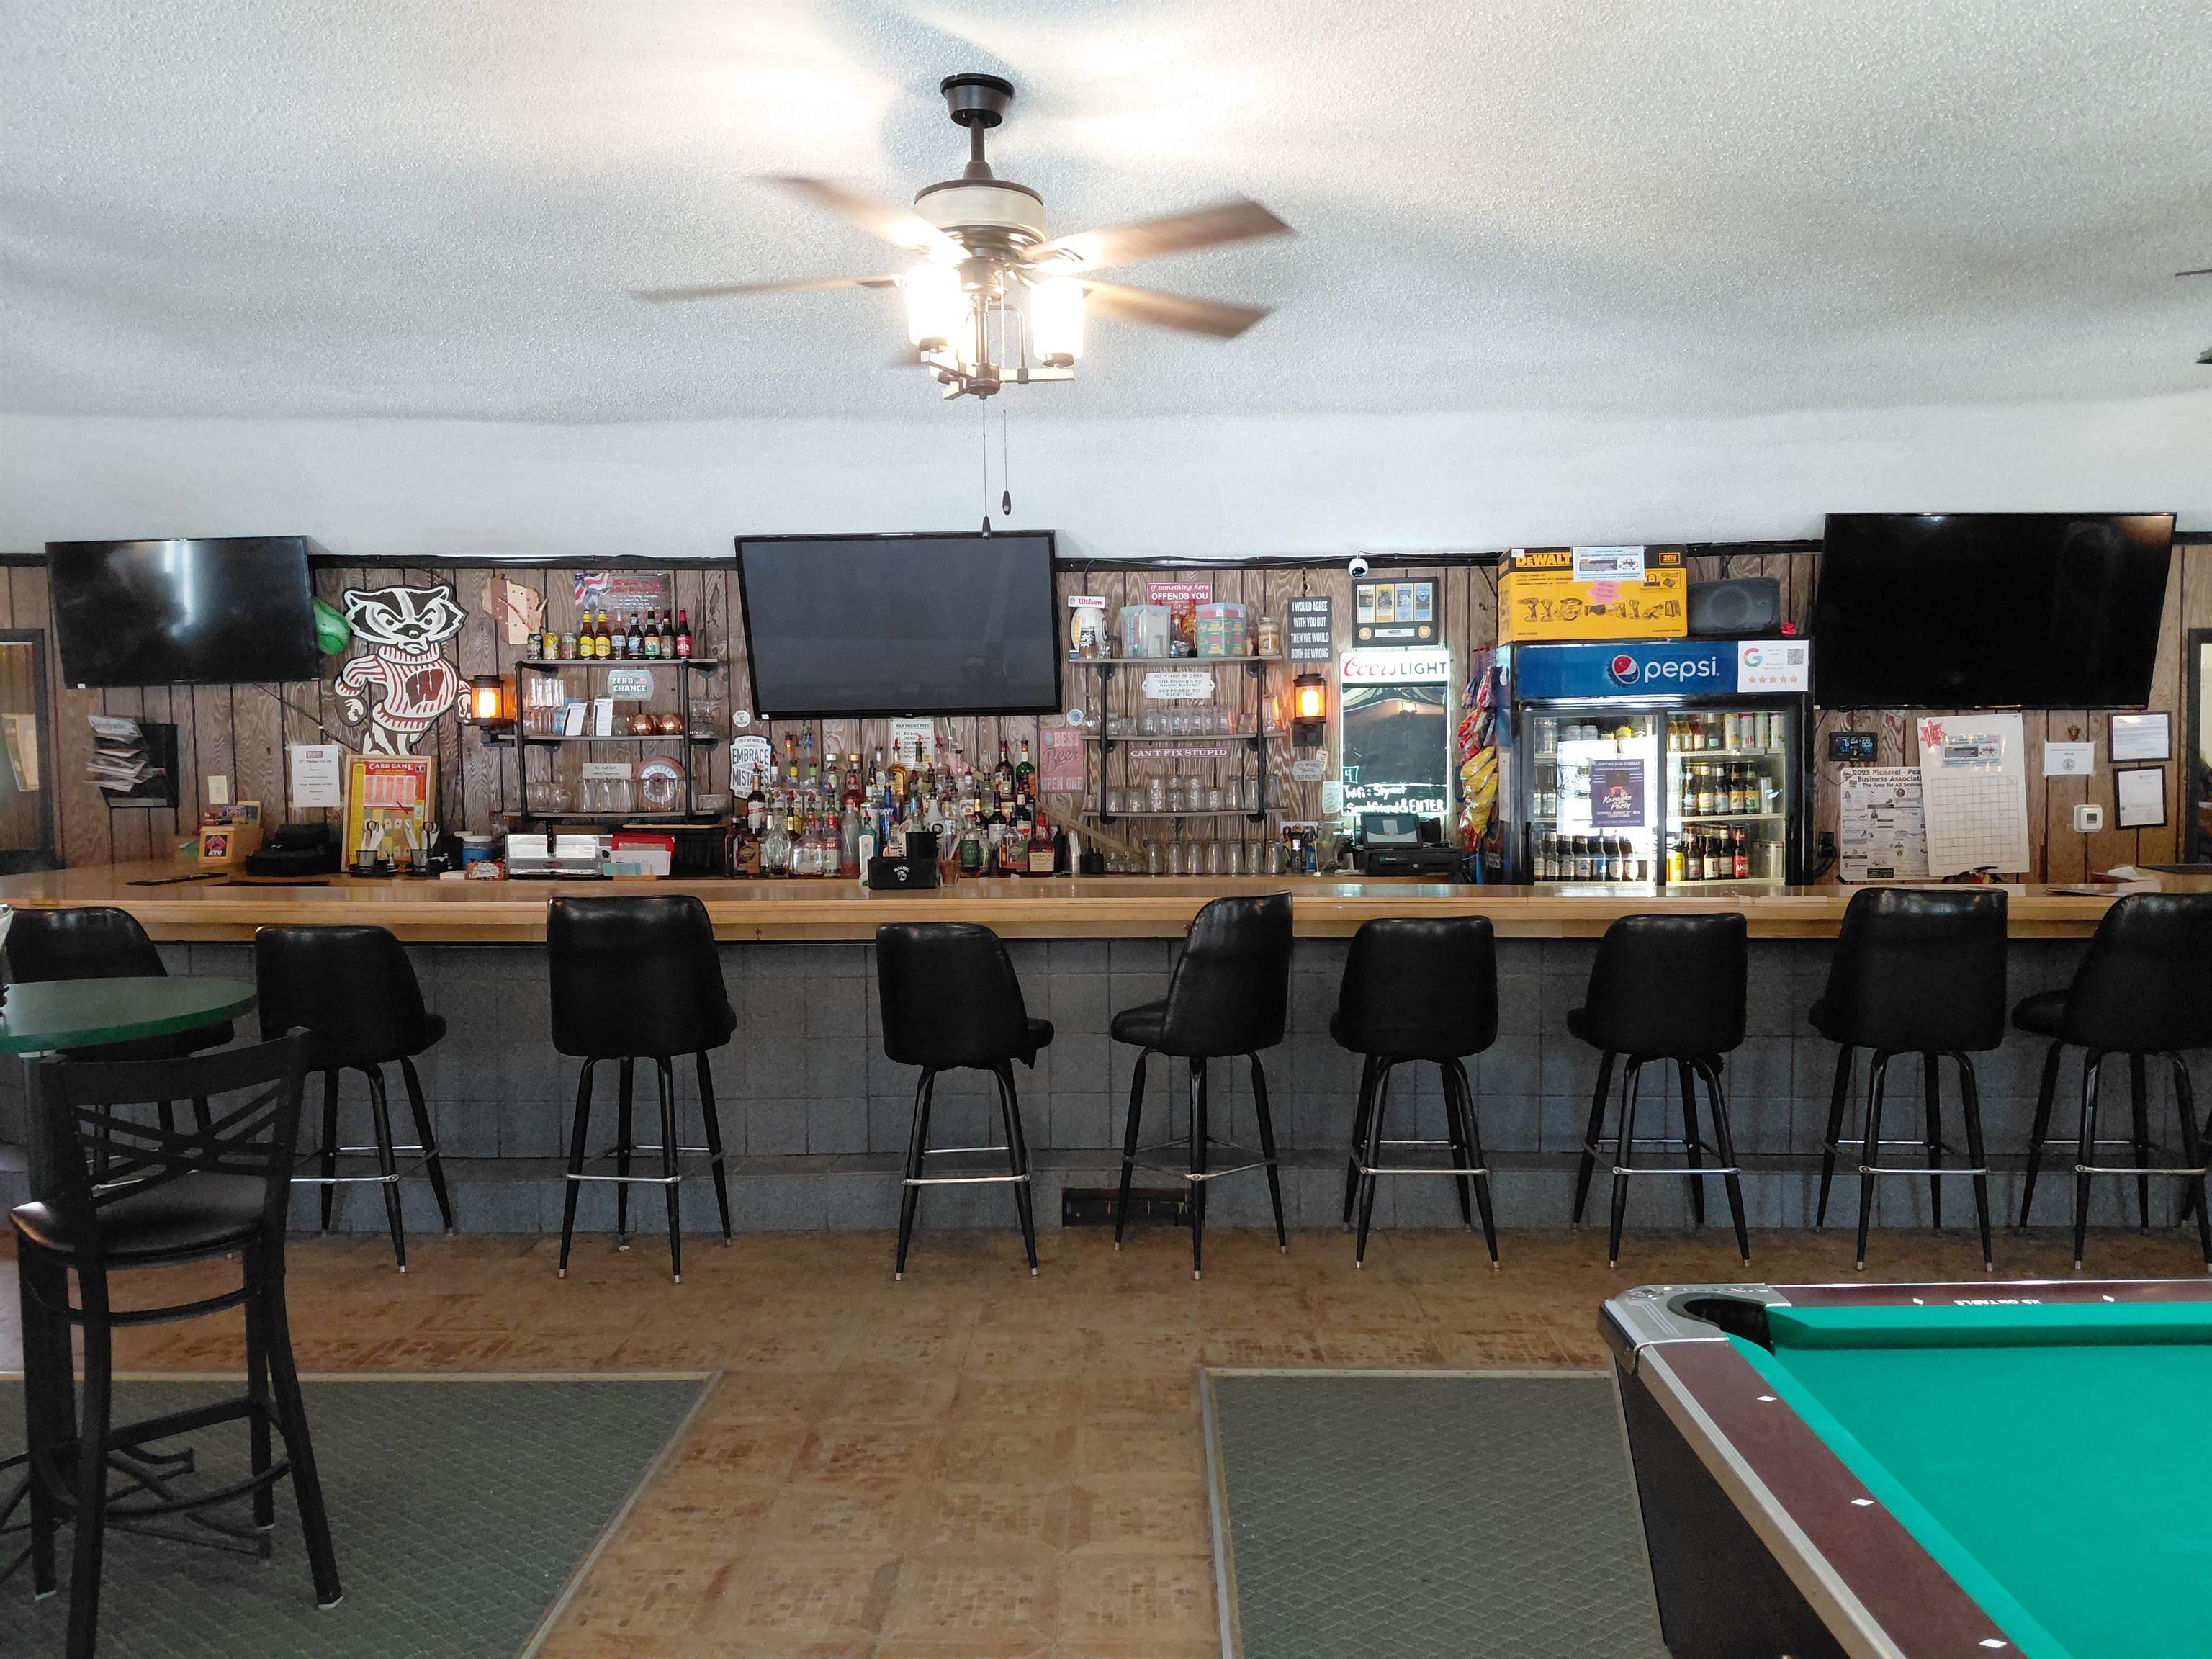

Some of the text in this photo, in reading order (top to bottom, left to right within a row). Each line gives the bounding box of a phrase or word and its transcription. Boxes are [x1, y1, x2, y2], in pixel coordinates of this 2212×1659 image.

[1516, 554, 1572, 566] DEWALT
[1295, 601, 1312, 612] WOULD
[1312, 601, 1328, 612] AGREE
[1293, 616, 1326, 628] WITH YOU BUT
[1290, 632, 1329, 644] THEN WE WOULD
[1291, 648, 1329, 659] BOTH BE WRONG
[1743, 647, 1763, 667] G
[1342, 657, 1447, 677] Coors LIGHT
[1644, 655, 1717, 683] pepsi
[1053, 731, 1080, 747] BEST
[732, 748, 769, 765] EMBRACE
[1042, 747, 1082, 775] Beer
[732, 767, 769, 786] MISTAES
[1040, 776, 1083, 791] OPEN ONE
[1603, 795, 1632, 804] Karaoke
[1610, 802, 1632, 811] Party
